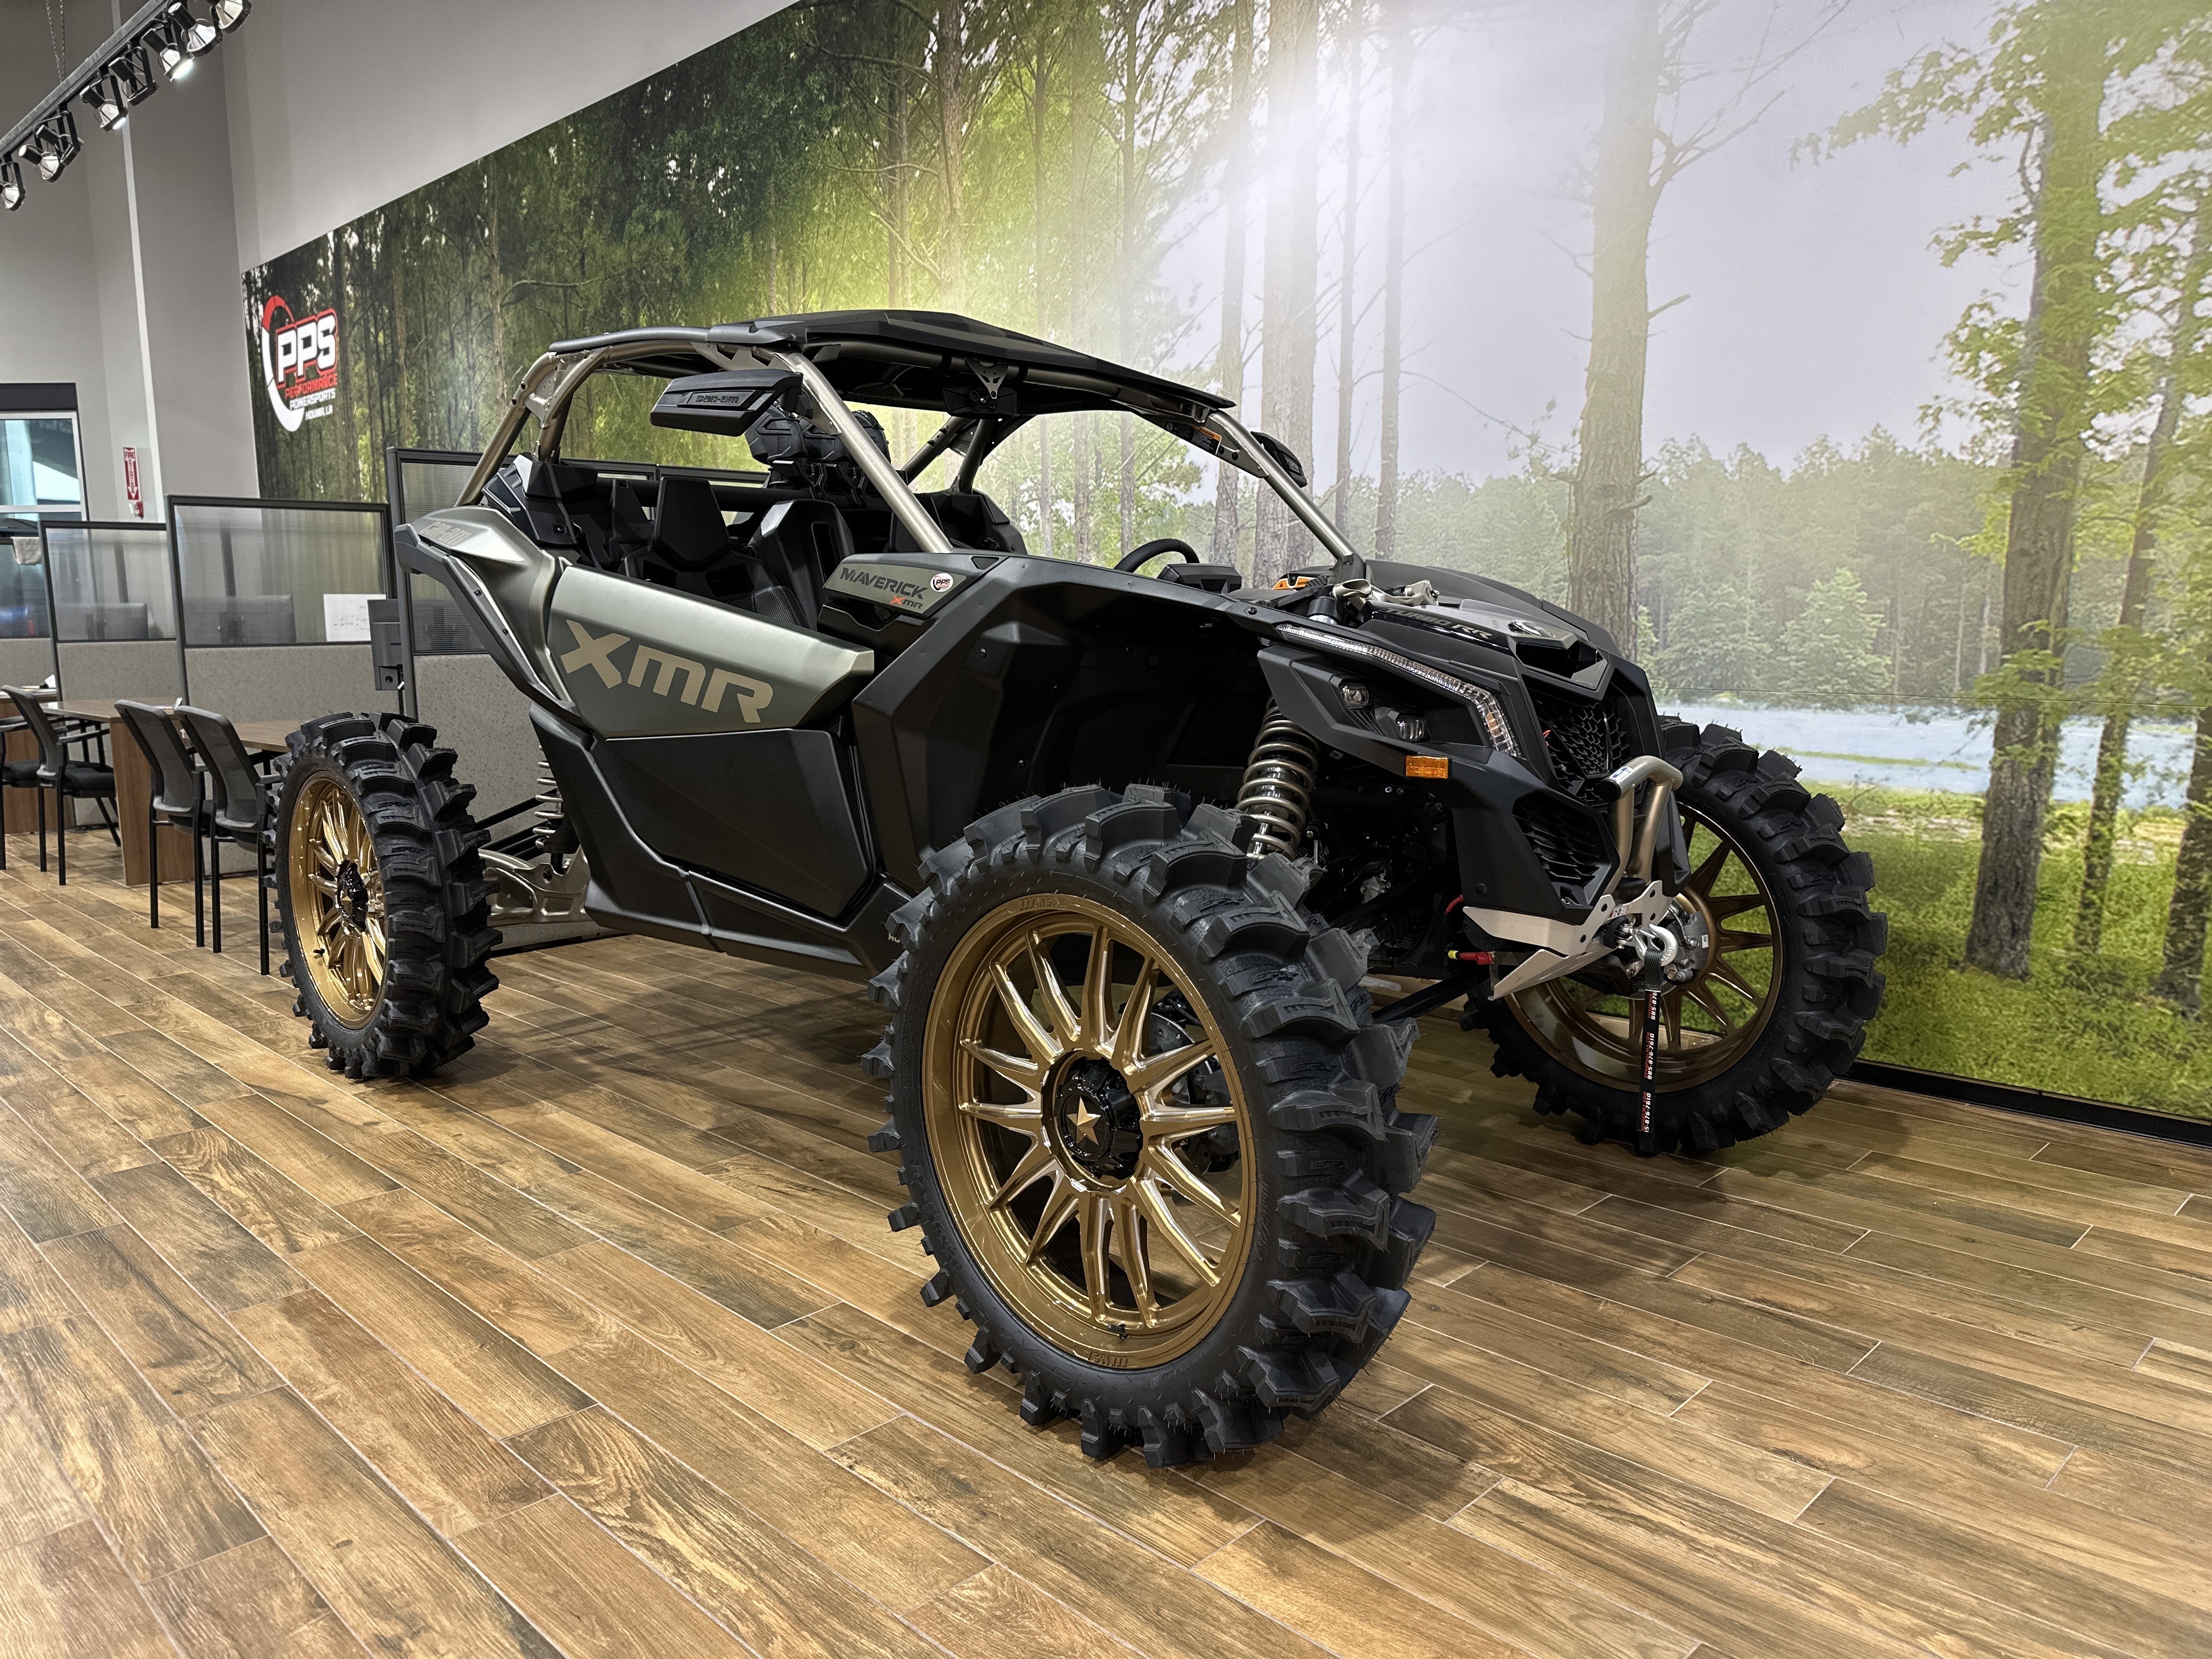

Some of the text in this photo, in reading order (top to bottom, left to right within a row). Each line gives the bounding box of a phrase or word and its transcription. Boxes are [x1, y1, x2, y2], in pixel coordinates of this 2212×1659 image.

[276, 313, 337, 384] PPS
[285, 373, 338, 400] PERFORMANCE
[289, 387, 336, 410] POWERSPORTS
[840, 567, 928, 600] MAVERICK
[1384, 608, 1493, 639] TURBO RR
